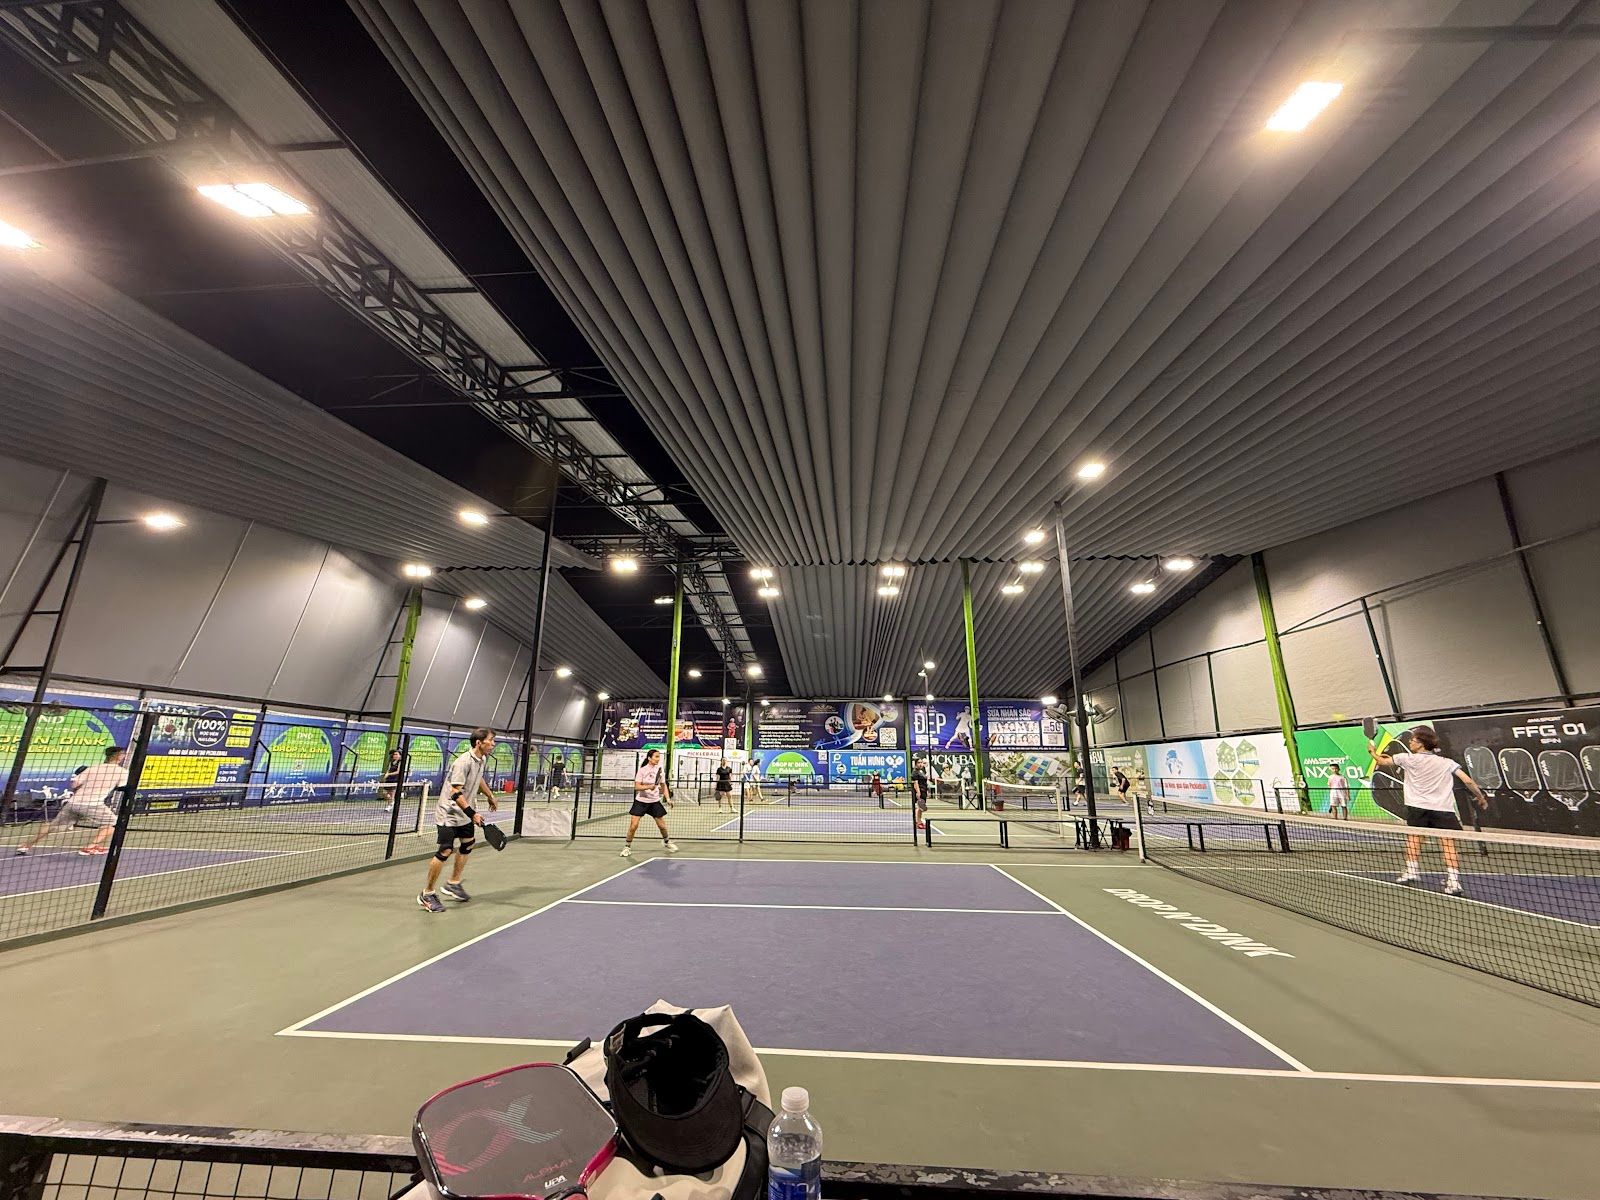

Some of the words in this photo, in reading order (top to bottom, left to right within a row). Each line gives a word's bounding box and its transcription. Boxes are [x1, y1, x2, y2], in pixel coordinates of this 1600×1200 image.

[38, 713, 65, 724] ND
[197, 719, 226, 731] 100%
[1511, 724, 1557, 738] FFG
[1562, 722, 1587, 736] 01
[59, 735, 106, 746] DINK
[0, 744, 72, 754] PICLEBALL
[925, 753, 976, 765] PICKLEBA
[1305, 765, 1332, 779] NX
[1345, 765, 1365, 779] 01
[1102, 888, 1179, 911] DROP
[1180, 923, 1296, 958] DINK
[544, 1174, 567, 1190] UPA
